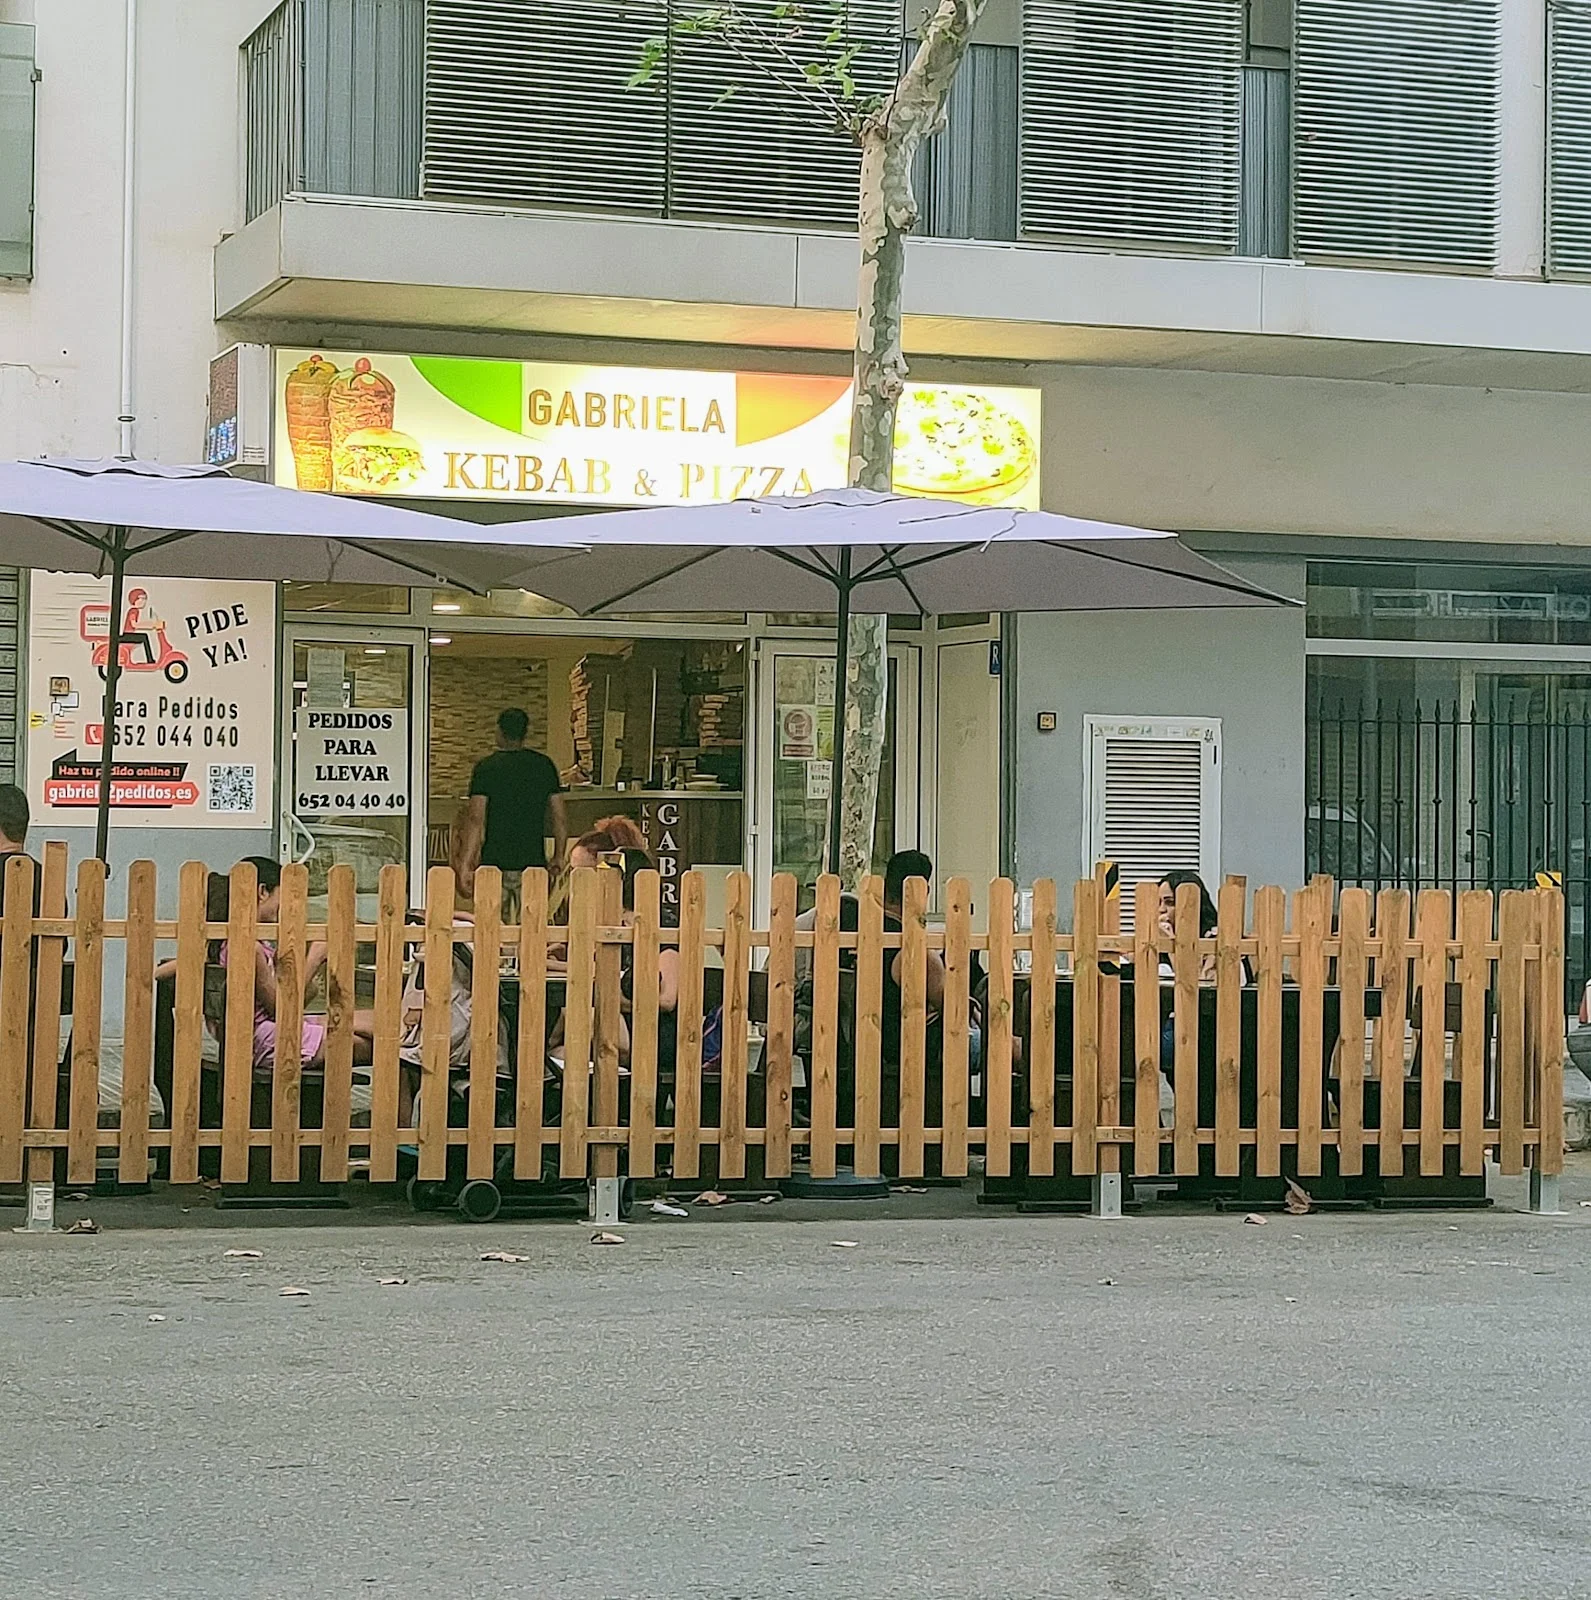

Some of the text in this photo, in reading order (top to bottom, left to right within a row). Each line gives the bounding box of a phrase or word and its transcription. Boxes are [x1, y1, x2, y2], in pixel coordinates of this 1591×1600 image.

[528, 388, 726, 434] GABRIELA
[443, 451, 814, 500] KEBAB & PIZZA
[185, 603, 249, 639] PIDE
[202, 638, 247, 668] YA!
[102, 695, 239, 719] ara Pedidos
[308, 712, 393, 730] PEDIDOS
[112, 724, 239, 748] 652 044 040
[324, 739, 378, 756] PARA
[58, 765, 80, 776] Haz
[81, 766, 94, 776] tu
[95, 766, 134, 778] pdido
[136, 766, 171, 777] online
[315, 765, 390, 782] LLEVAR
[48, 783, 192, 803] gabriel2pedidos.es
[298, 792, 406, 809] 652 04 40 40
